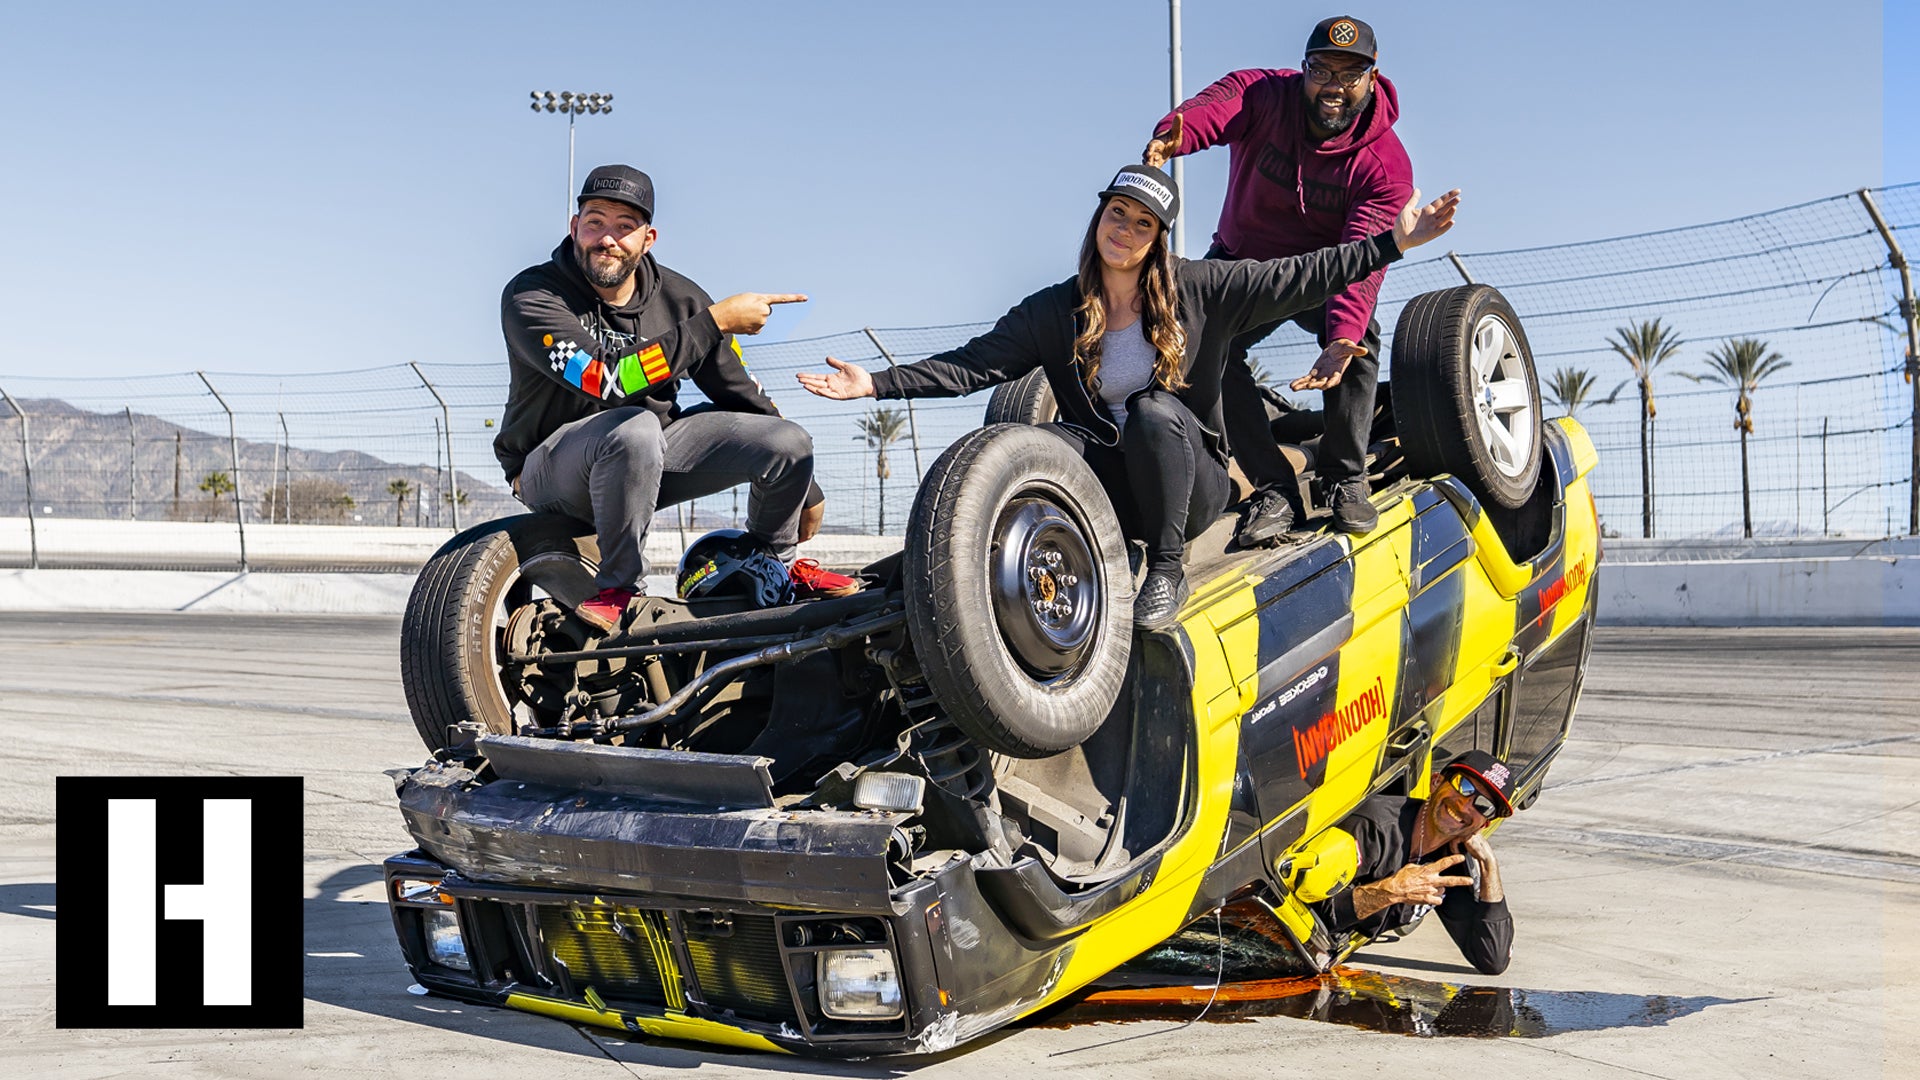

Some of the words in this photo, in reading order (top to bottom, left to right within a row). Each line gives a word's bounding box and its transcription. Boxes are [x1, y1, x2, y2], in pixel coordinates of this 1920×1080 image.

[471, 612, 484, 654] HTR
[1278, 666, 1329, 707] CHEROKEE
[1250, 700, 1277, 725] SPORT
